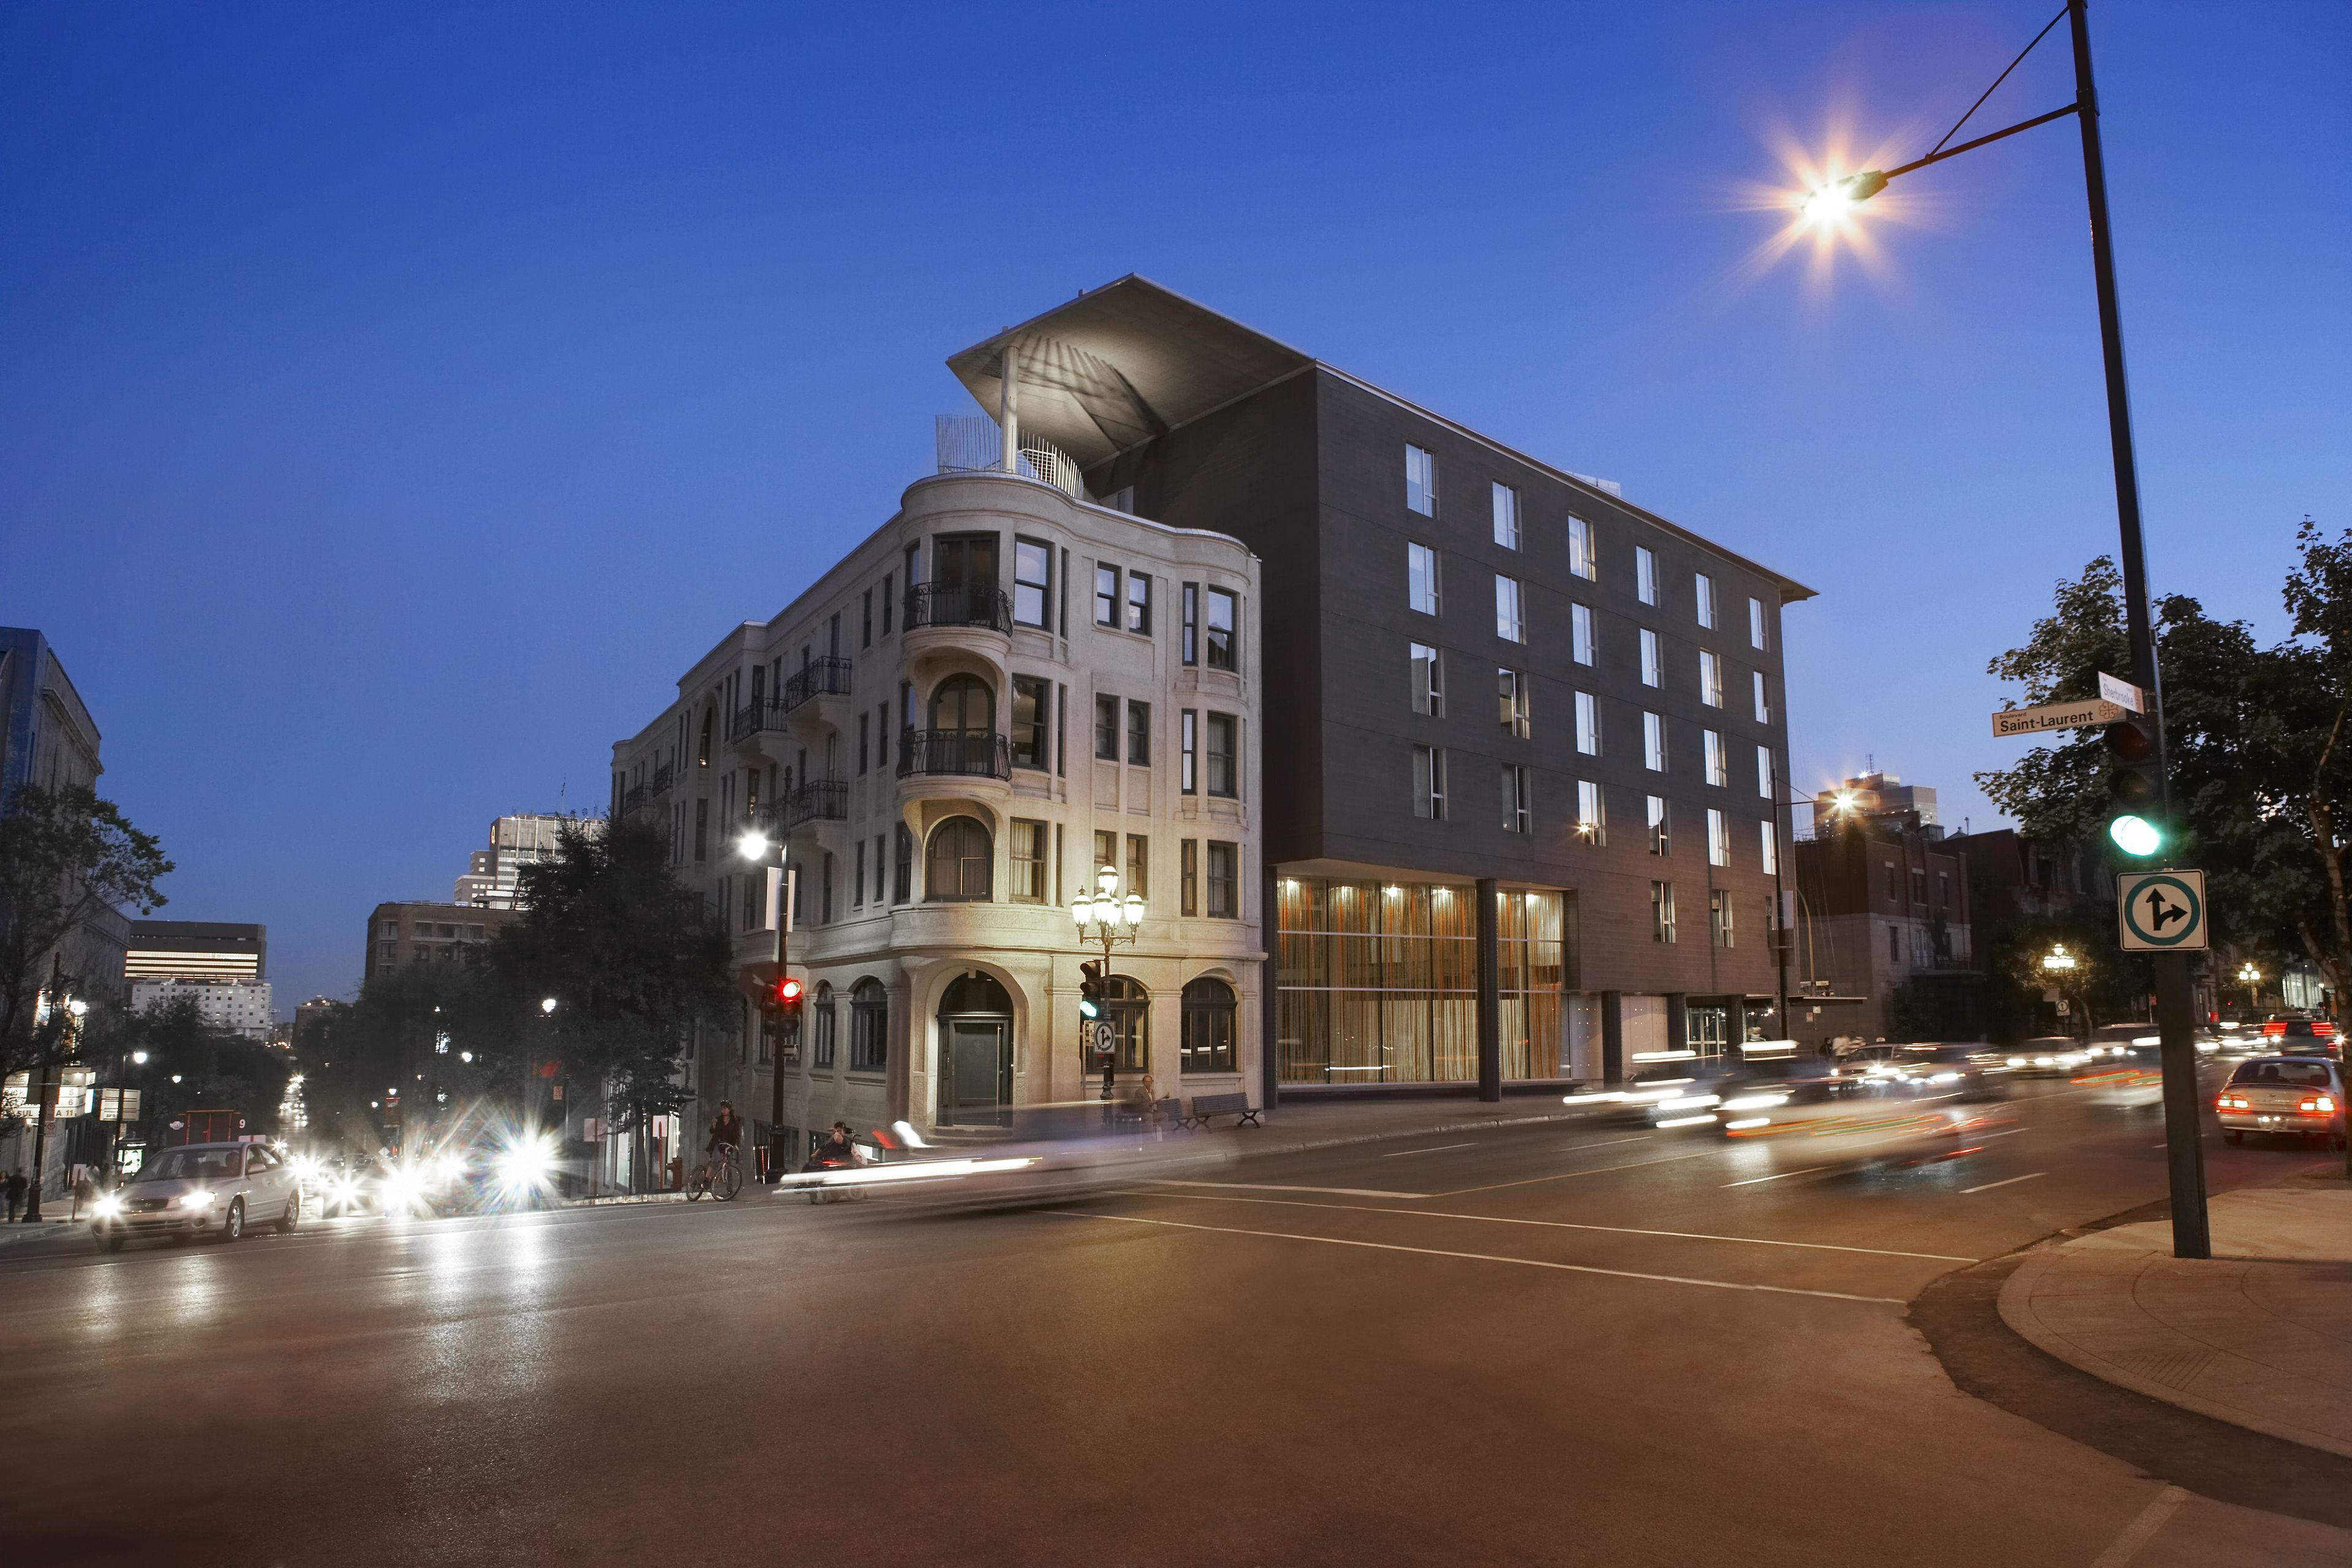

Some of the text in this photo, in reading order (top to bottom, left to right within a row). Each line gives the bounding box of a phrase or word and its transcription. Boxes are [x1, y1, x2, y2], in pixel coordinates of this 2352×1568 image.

[2103, 682, 2134, 706] Sherbrooke
[2000, 710, 2094, 732] Saint-Laurent
[239, 1119, 246, 1129] 9
